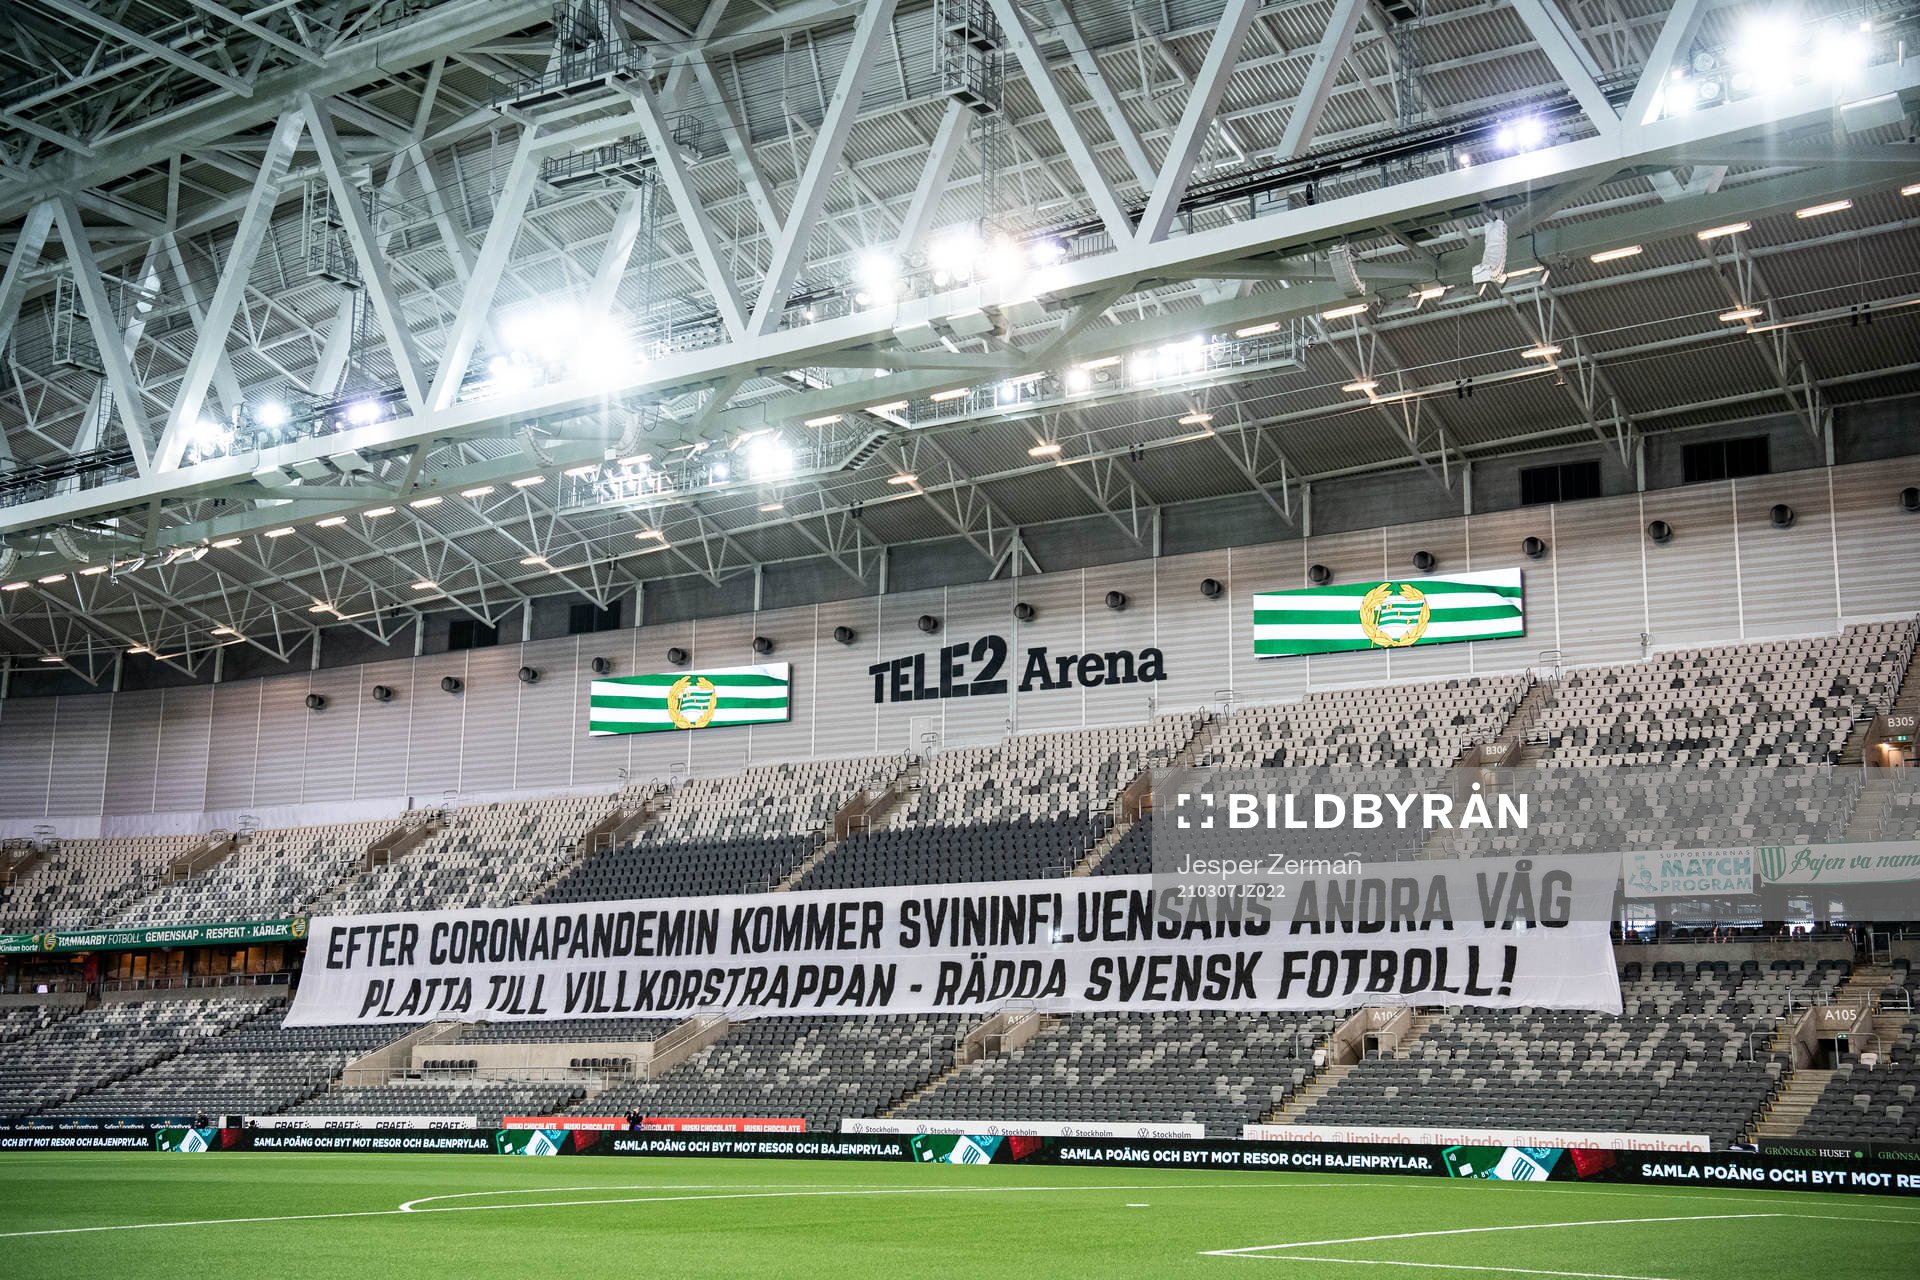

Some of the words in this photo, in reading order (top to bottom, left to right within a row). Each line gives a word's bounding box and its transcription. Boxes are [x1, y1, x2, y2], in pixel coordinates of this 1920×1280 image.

[869, 635, 1007, 703] TELE2
[1019, 646, 1167, 691] Arena
[1887, 717, 1914, 727] B305
[1661, 857, 1751, 877] MATCH
[1789, 847, 1846, 881] Bajen
[1850, 855, 1872, 869] va
[1661, 878, 1751, 892] PROGRAM
[326, 922, 418, 970] EFTER
[430, 909, 719, 966] CORONAPANDEMIN
[731, 901, 884, 955] KOMMER
[899, 883, 1271, 948] SVININFLUENSANS
[1289, 875, 1454, 934] ANDRA
[1477, 859, 1573, 931] VÅG
[59, 935, 107, 946] HAMMARBY
[108, 933, 141, 944] FOTBOLL
[145, 930, 199, 942] GEMENSKAP
[206, 927, 245, 939] RESPEKT
[253, 923, 288, 937] KÄRLEK
[359, 977, 473, 1017] PLATTA
[485, 974, 547, 1015] TILL
[563, 963, 897, 1014] VILLKORSTRAPPAN
[933, 952, 1066, 1006] RÄDDA
[1084, 950, 1263, 1002] SVENSK
[1277, 945, 1518, 1000] FOTBOLL!
[1373, 1011, 1399, 1021] A10
[1825, 1010, 1857, 1020] A105
[930, 1127, 965, 1135] Stockholm
[1001, 1128, 1037, 1136] Stockholm
[1076, 1129, 1113, 1137] Stockholm
[1152, 1131, 1191, 1139] Stockholm
[1261, 1130, 1322, 1141] limitado
[2, 1138, 17, 1147] OCH
[18, 1138, 33, 1147] BYT
[33, 1138, 50, 1147] MOT
[51, 1138, 75, 1147] RESOR
[76, 1138, 92, 1147] OCH
[93, 1138, 149, 1147] BAJENPRYLAR.
[254, 1138, 282, 1147] SAMLA
[283, 1135, 313, 1147] POÄNG
[314, 1138, 333, 1147] OCH
[334, 1138, 351, 1147] BYT
[352, 1138, 371, 1147] MOT
[372, 1138, 401, 1148] RESOR
[403, 1139, 422, 1148] OCH
[423, 1139, 489, 1149] BAJENPRYLAR.
[1347, 1132, 1410, 1145] limitado
[1435, 1134, 1502, 1147] limitado
[1528, 1136, 1599, 1149] limitado
[614, 1140, 648, 1151] SAMLA
[651, 1138, 686, 1152] POÄNG
[688, 1142, 710, 1152] OCH
[712, 1142, 732, 1152] BYT
[734, 1142, 757, 1153] MOT
[759, 1143, 793, 1154] RESOR
[796, 1144, 819, 1154] OCH
[821, 1144, 902, 1156] BAJENPRYLAR.
[1627, 1139, 1701, 1153] limitado
[1765, 1145, 1817, 1156] GRÖNSAKS
[1819, 1149, 1851, 1158] HUSET
[1060, 1148, 1102, 1161] SAMLA
[1106, 1147, 1149, 1162] POÄNG
[1153, 1151, 1180, 1162] OCH
[1183, 1151, 1208, 1163] BYT
[1211, 1152, 1240, 1164] MOT
[1243, 1152, 1288, 1165] RESOR
[1292, 1154, 1321, 1166] OCH
[1325, 1155, 1432, 1169] BAJENPRYLAR.
[1878, 1150, 1920, 1160] GRÖNSA
[1642, 1164, 1699, 1178] SAMLA
[1704, 1164, 1764, 1181] POÄNG
[1769, 1169, 1807, 1183] OCH
[1812, 1170, 1847, 1184] BYT
[1851, 1172, 1892, 1187] MOT
[1897, 1174, 1920, 1188] RE
